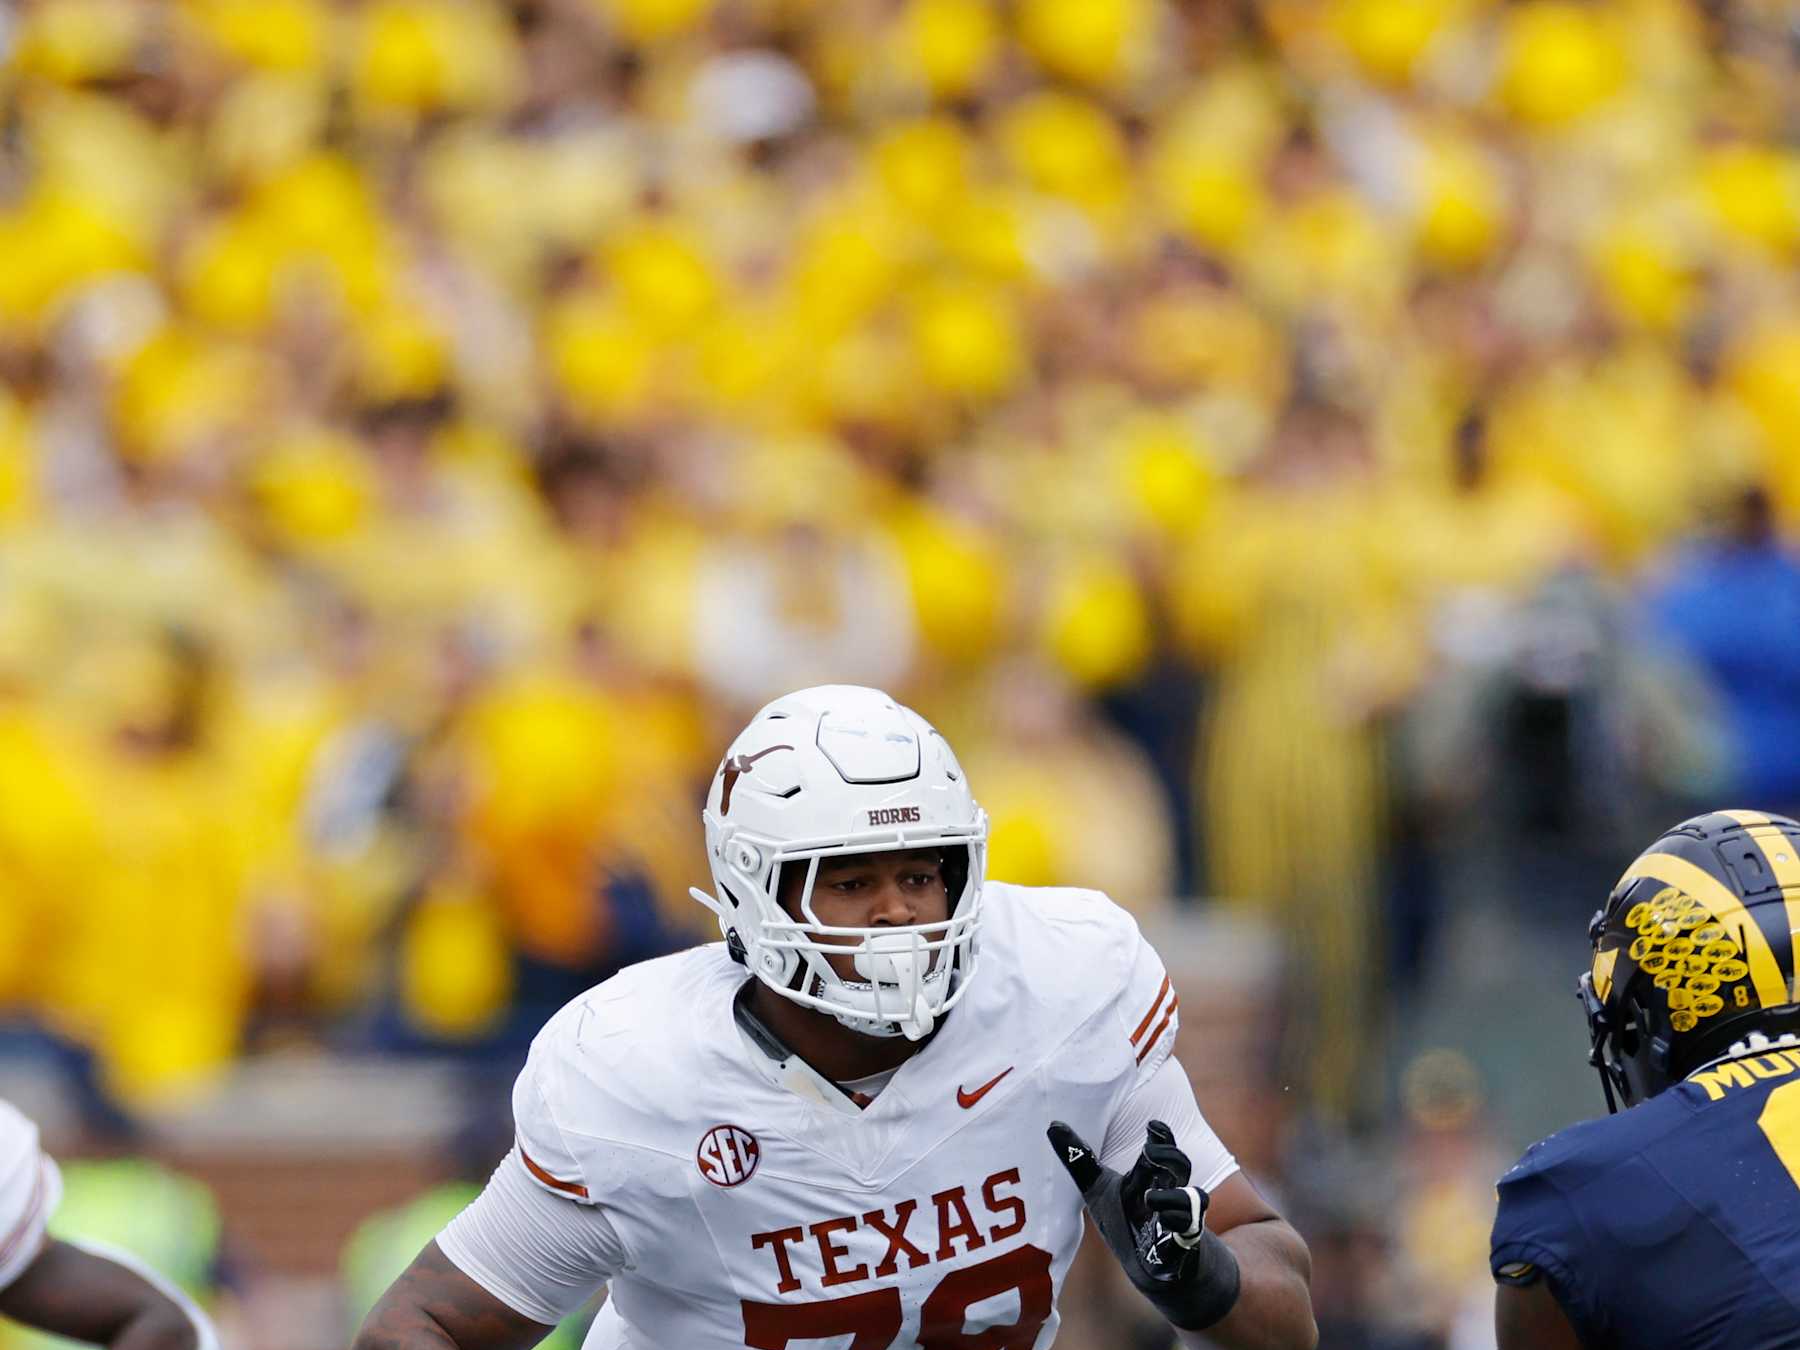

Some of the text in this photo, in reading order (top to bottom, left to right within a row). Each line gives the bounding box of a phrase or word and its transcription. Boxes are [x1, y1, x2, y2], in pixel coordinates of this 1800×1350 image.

[867, 806, 921, 826] HORNS
[1734, 985, 1749, 1007] 8
[699, 1126, 758, 1184] SEC
[752, 1167, 1028, 1294] TEXAS
